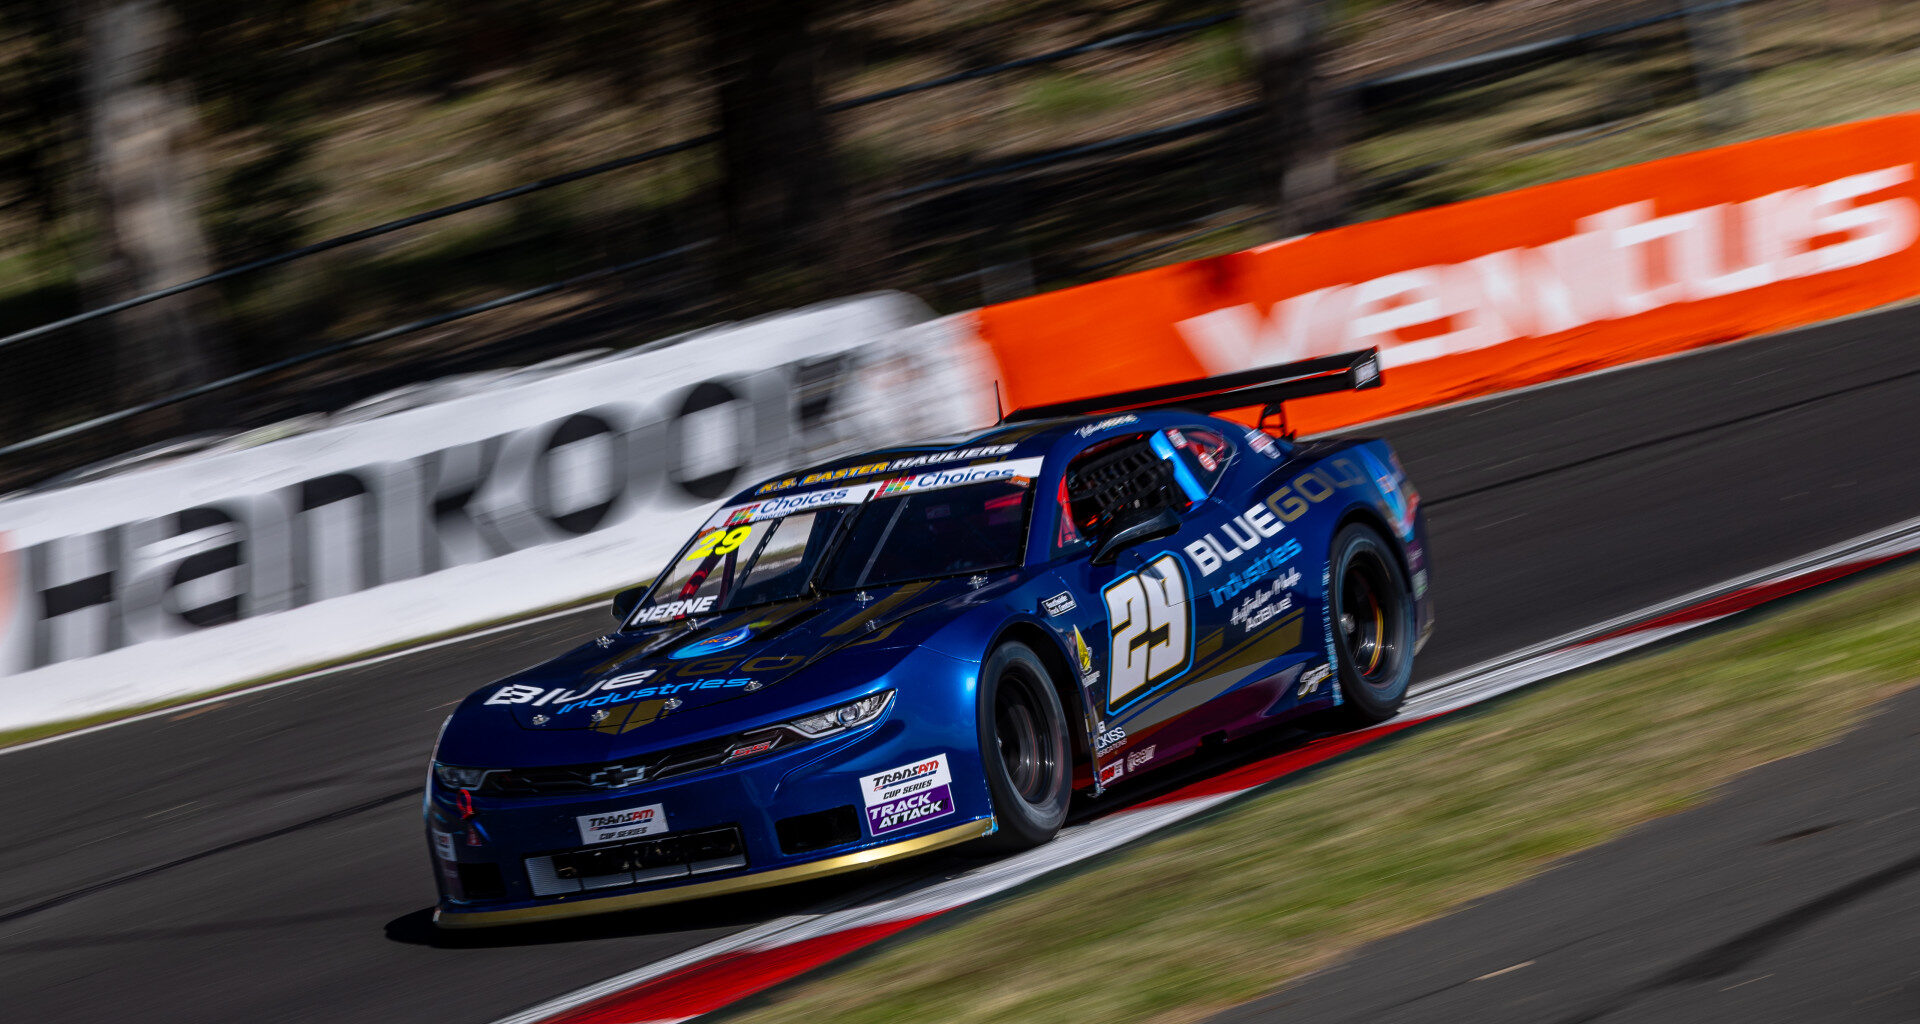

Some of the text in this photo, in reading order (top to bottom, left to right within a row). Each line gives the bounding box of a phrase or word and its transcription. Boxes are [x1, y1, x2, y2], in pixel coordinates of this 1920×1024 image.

[1176, 163, 1918, 374] ventus
[798, 461, 889, 487] EASTER
[886, 443, 1018, 472] HAULIERS
[918, 467, 1015, 488] Choices
[760, 488, 848, 515] Choices
[687, 525, 752, 562] 29
[630, 595, 718, 626] HERNE
[1104, 555, 1188, 705] 29
[882, 779, 933, 801] CUP SERIES
[869, 792, 932, 821] TRACK
[878, 800, 943, 830] ATTACK
[598, 826, 649, 841] CUP SERIES
